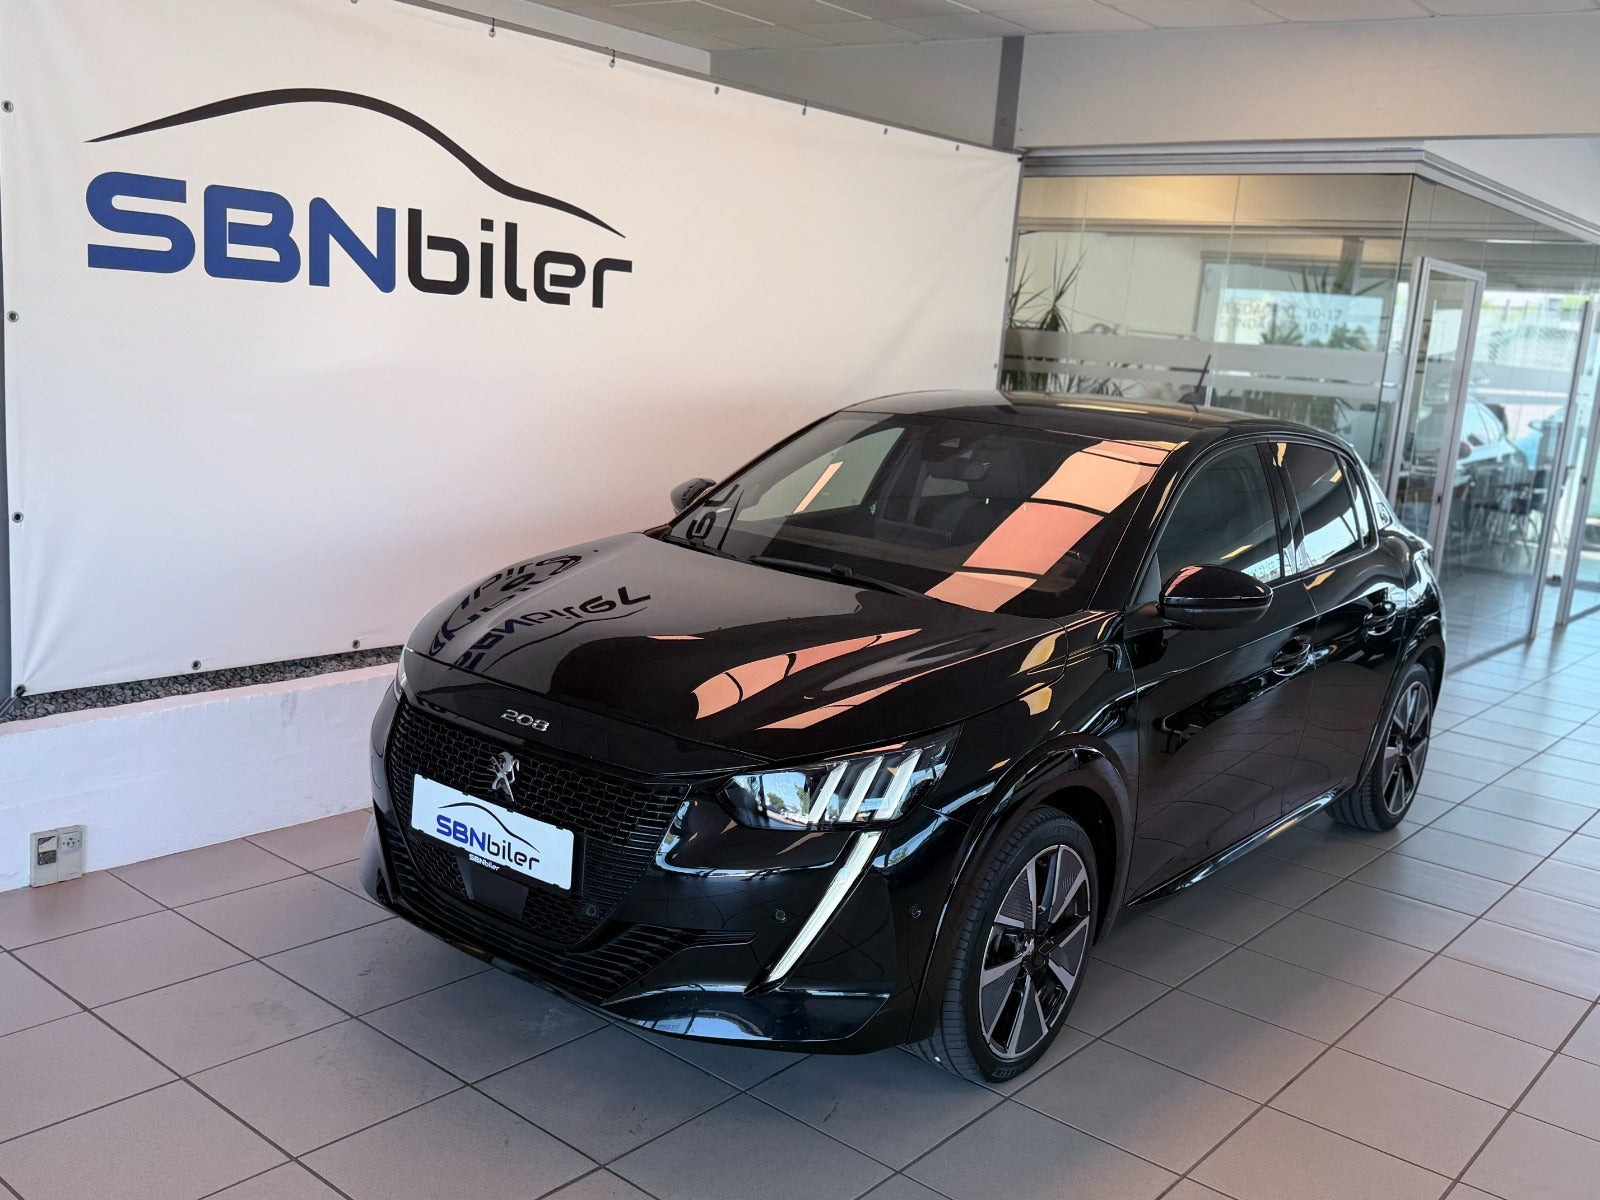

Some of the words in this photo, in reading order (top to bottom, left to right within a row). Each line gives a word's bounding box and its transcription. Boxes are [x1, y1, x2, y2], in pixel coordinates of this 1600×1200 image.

[86, 172, 632, 308] SBNbiler
[501, 709, 549, 731] 208
[436, 814, 540, 871] SBNbiler
